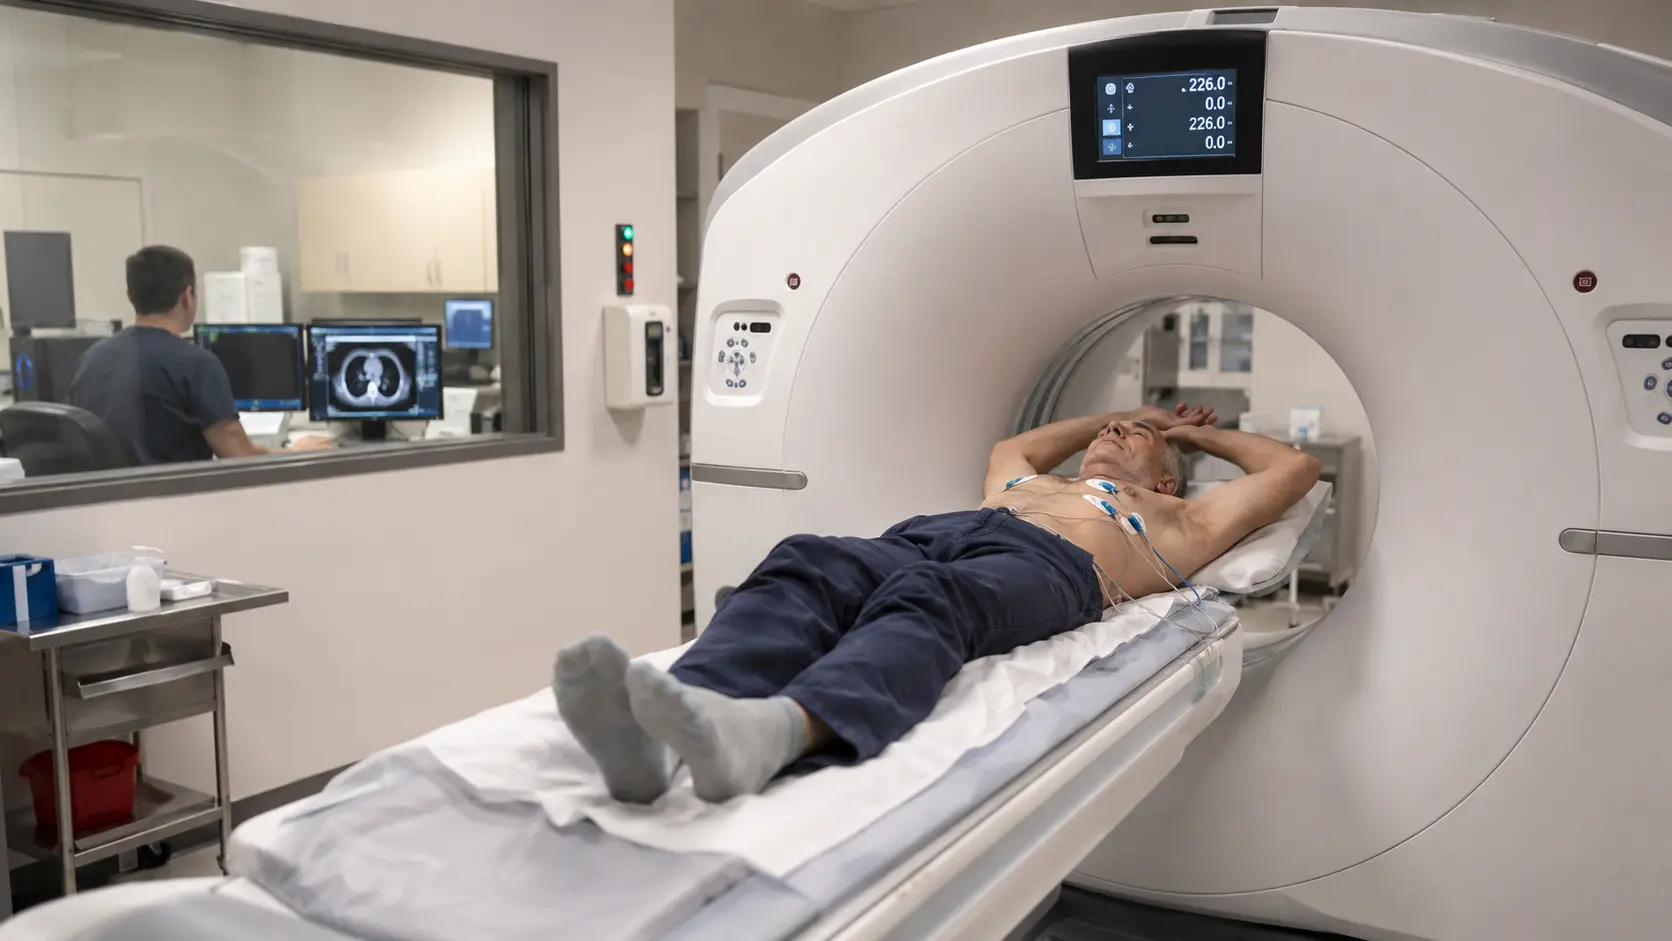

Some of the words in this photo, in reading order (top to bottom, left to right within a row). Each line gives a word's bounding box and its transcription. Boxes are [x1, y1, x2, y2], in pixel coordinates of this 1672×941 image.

[1189, 76, 1226, 92] 226.0
[1205, 96, 1226, 110] 0.0
[1189, 116, 1225, 131] 226.0
[1205, 135, 1225, 149] 0.0
